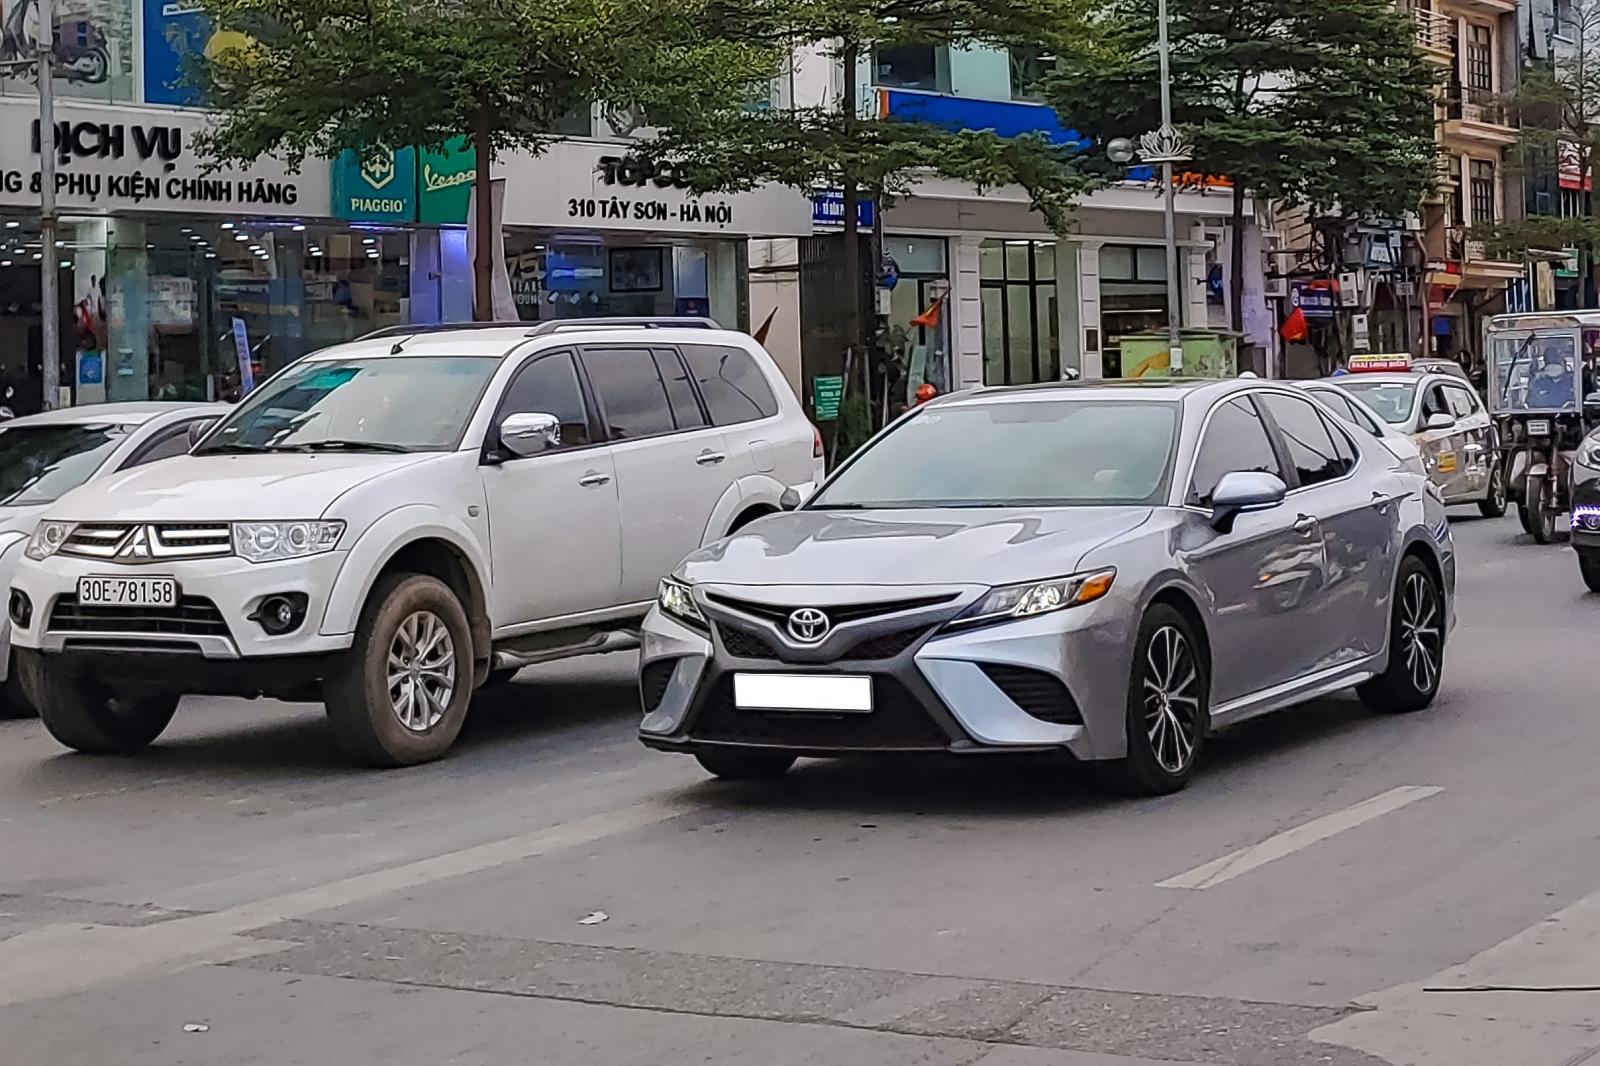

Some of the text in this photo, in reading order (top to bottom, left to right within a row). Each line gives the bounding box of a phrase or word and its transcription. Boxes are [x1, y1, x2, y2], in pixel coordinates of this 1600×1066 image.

[131, 126, 181, 173] VỤ
[54, 172, 101, 202] PHỤ
[108, 171, 160, 203] KIỆN
[166, 176, 231, 202] CHÍNH
[238, 178, 298, 205] HÃNG
[424, 164, 477, 191] Vespa
[350, 198, 403, 213] PIAGGIO
[568, 198, 596, 217] 310
[598, 196, 630, 219] TÂY
[633, 200, 667, 220] SƠN
[680, 200, 701, 222] HÀ
[705, 201, 732, 228] NỘI
[82, 580, 172, 603] 30E-781.58
